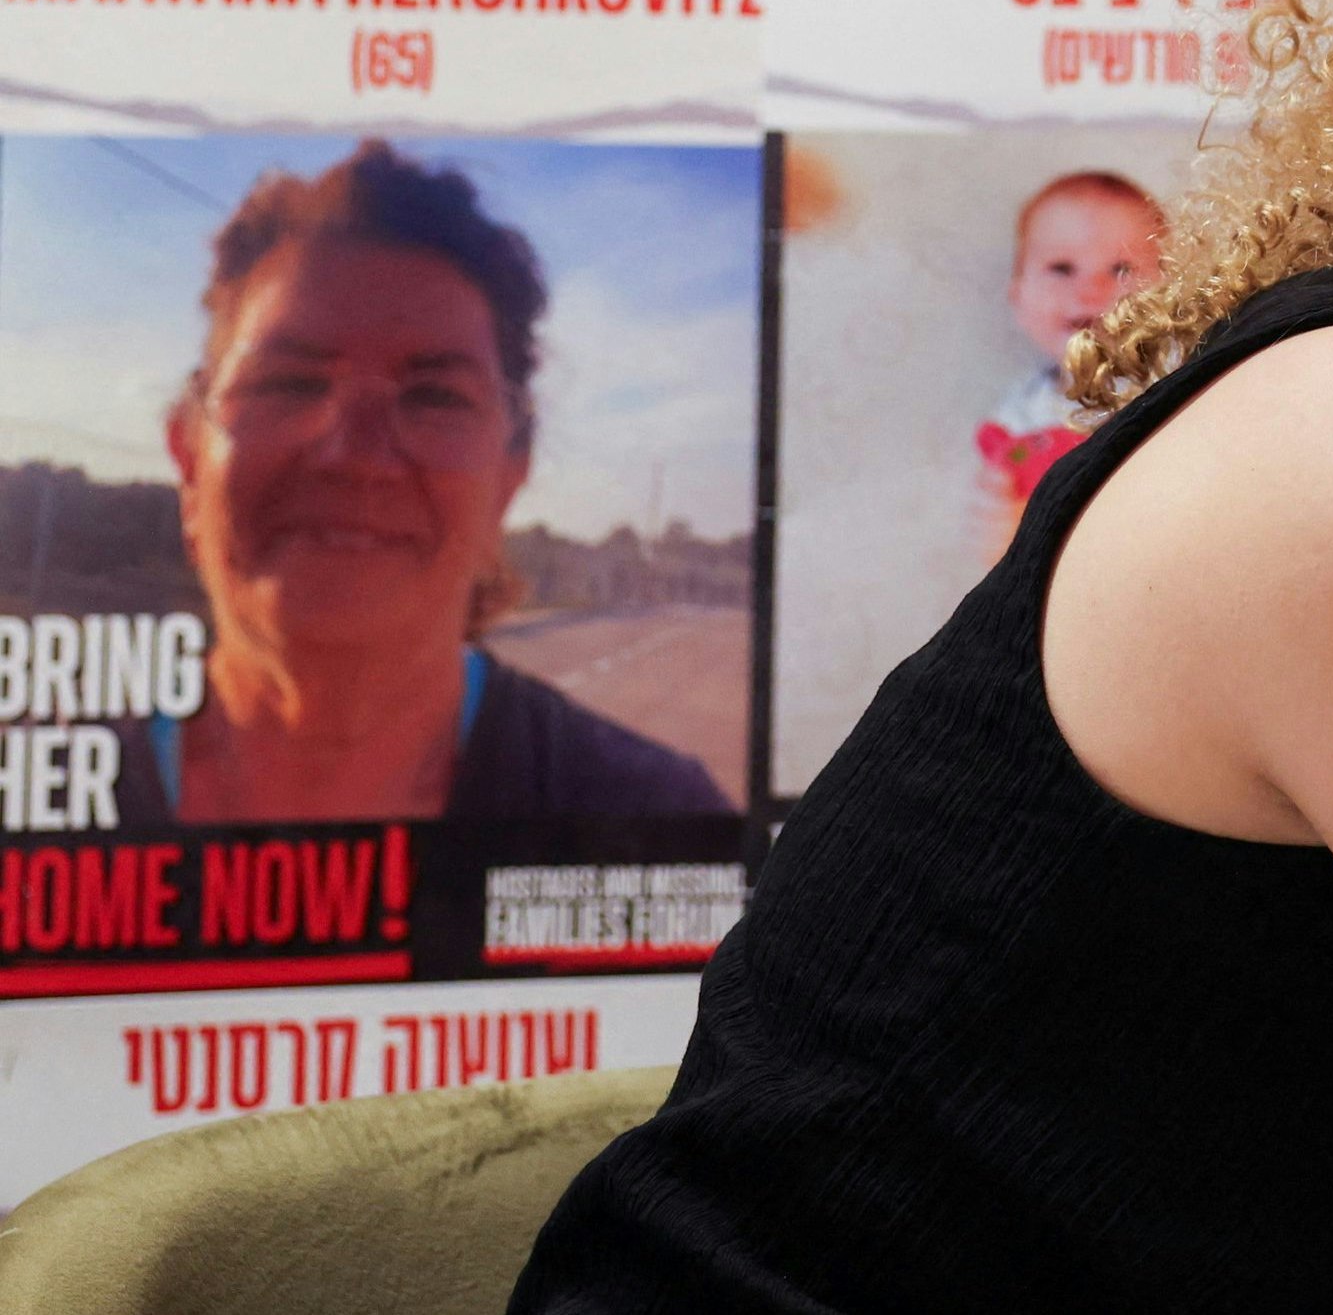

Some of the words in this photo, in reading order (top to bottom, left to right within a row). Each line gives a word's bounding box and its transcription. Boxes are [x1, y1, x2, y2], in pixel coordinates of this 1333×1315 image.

[351, 27, 435, 96] (65)
[0, 611, 207, 722] BRING
[201, 823, 411, 946] NOW!
